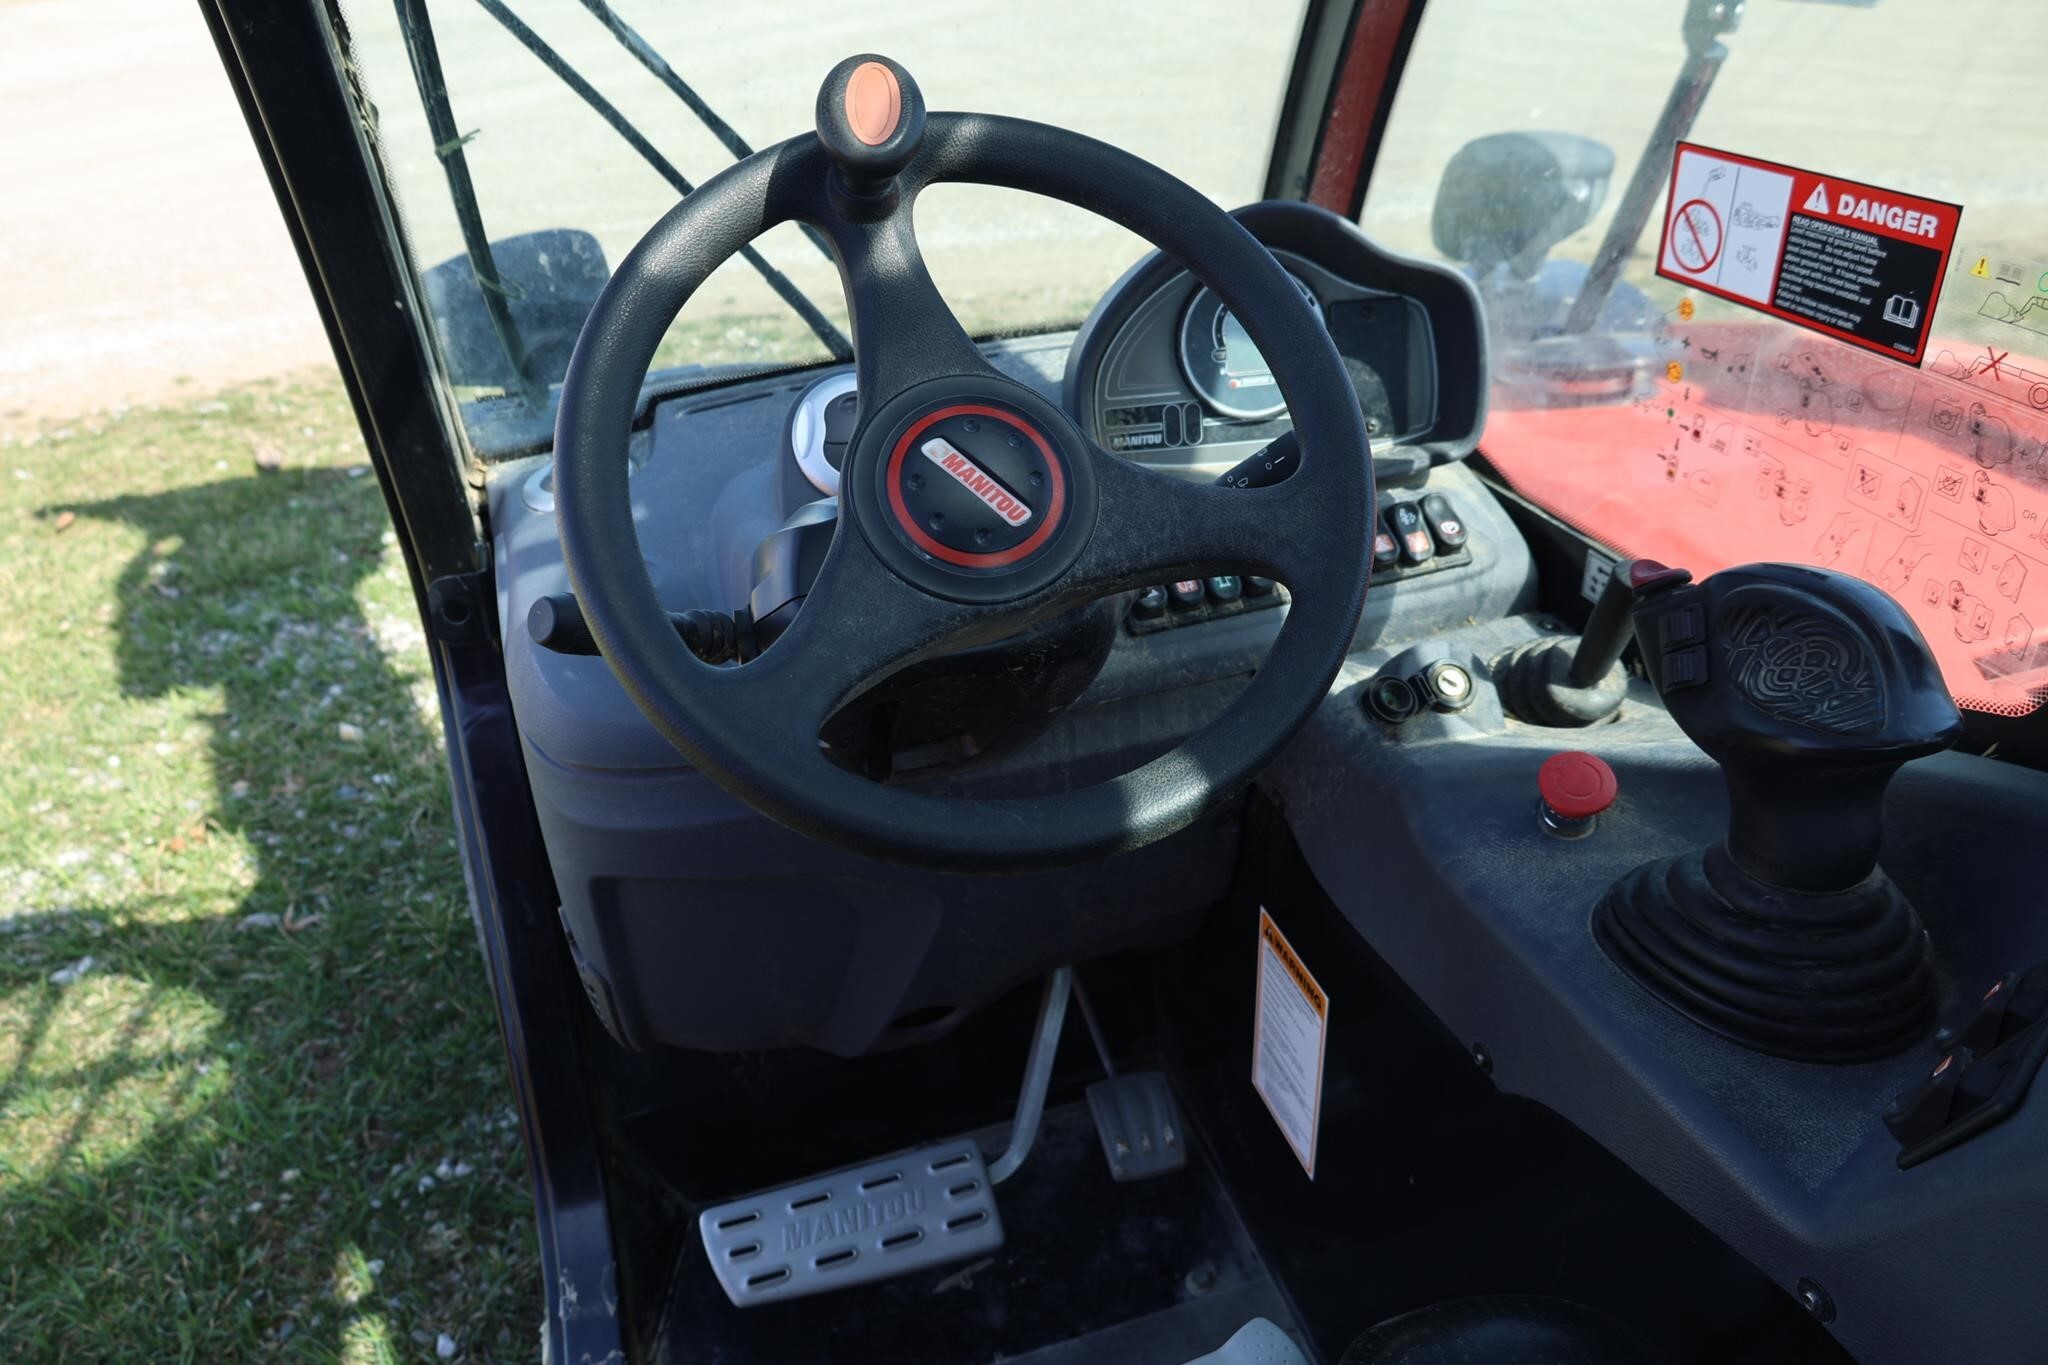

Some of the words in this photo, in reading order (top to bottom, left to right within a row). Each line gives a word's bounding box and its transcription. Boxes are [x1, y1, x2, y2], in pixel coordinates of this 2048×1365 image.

[1836, 193, 1938, 239] DANGER
[1851, 231, 1879, 244] MANUAL
[1112, 433, 1162, 447] MANITOU
[941, 452, 1027, 522] MANITOU
[2022, 509, 2038, 523] OR
[1274, 939, 1323, 1010] WARNING
[781, 1187, 926, 1252] MANITOU
